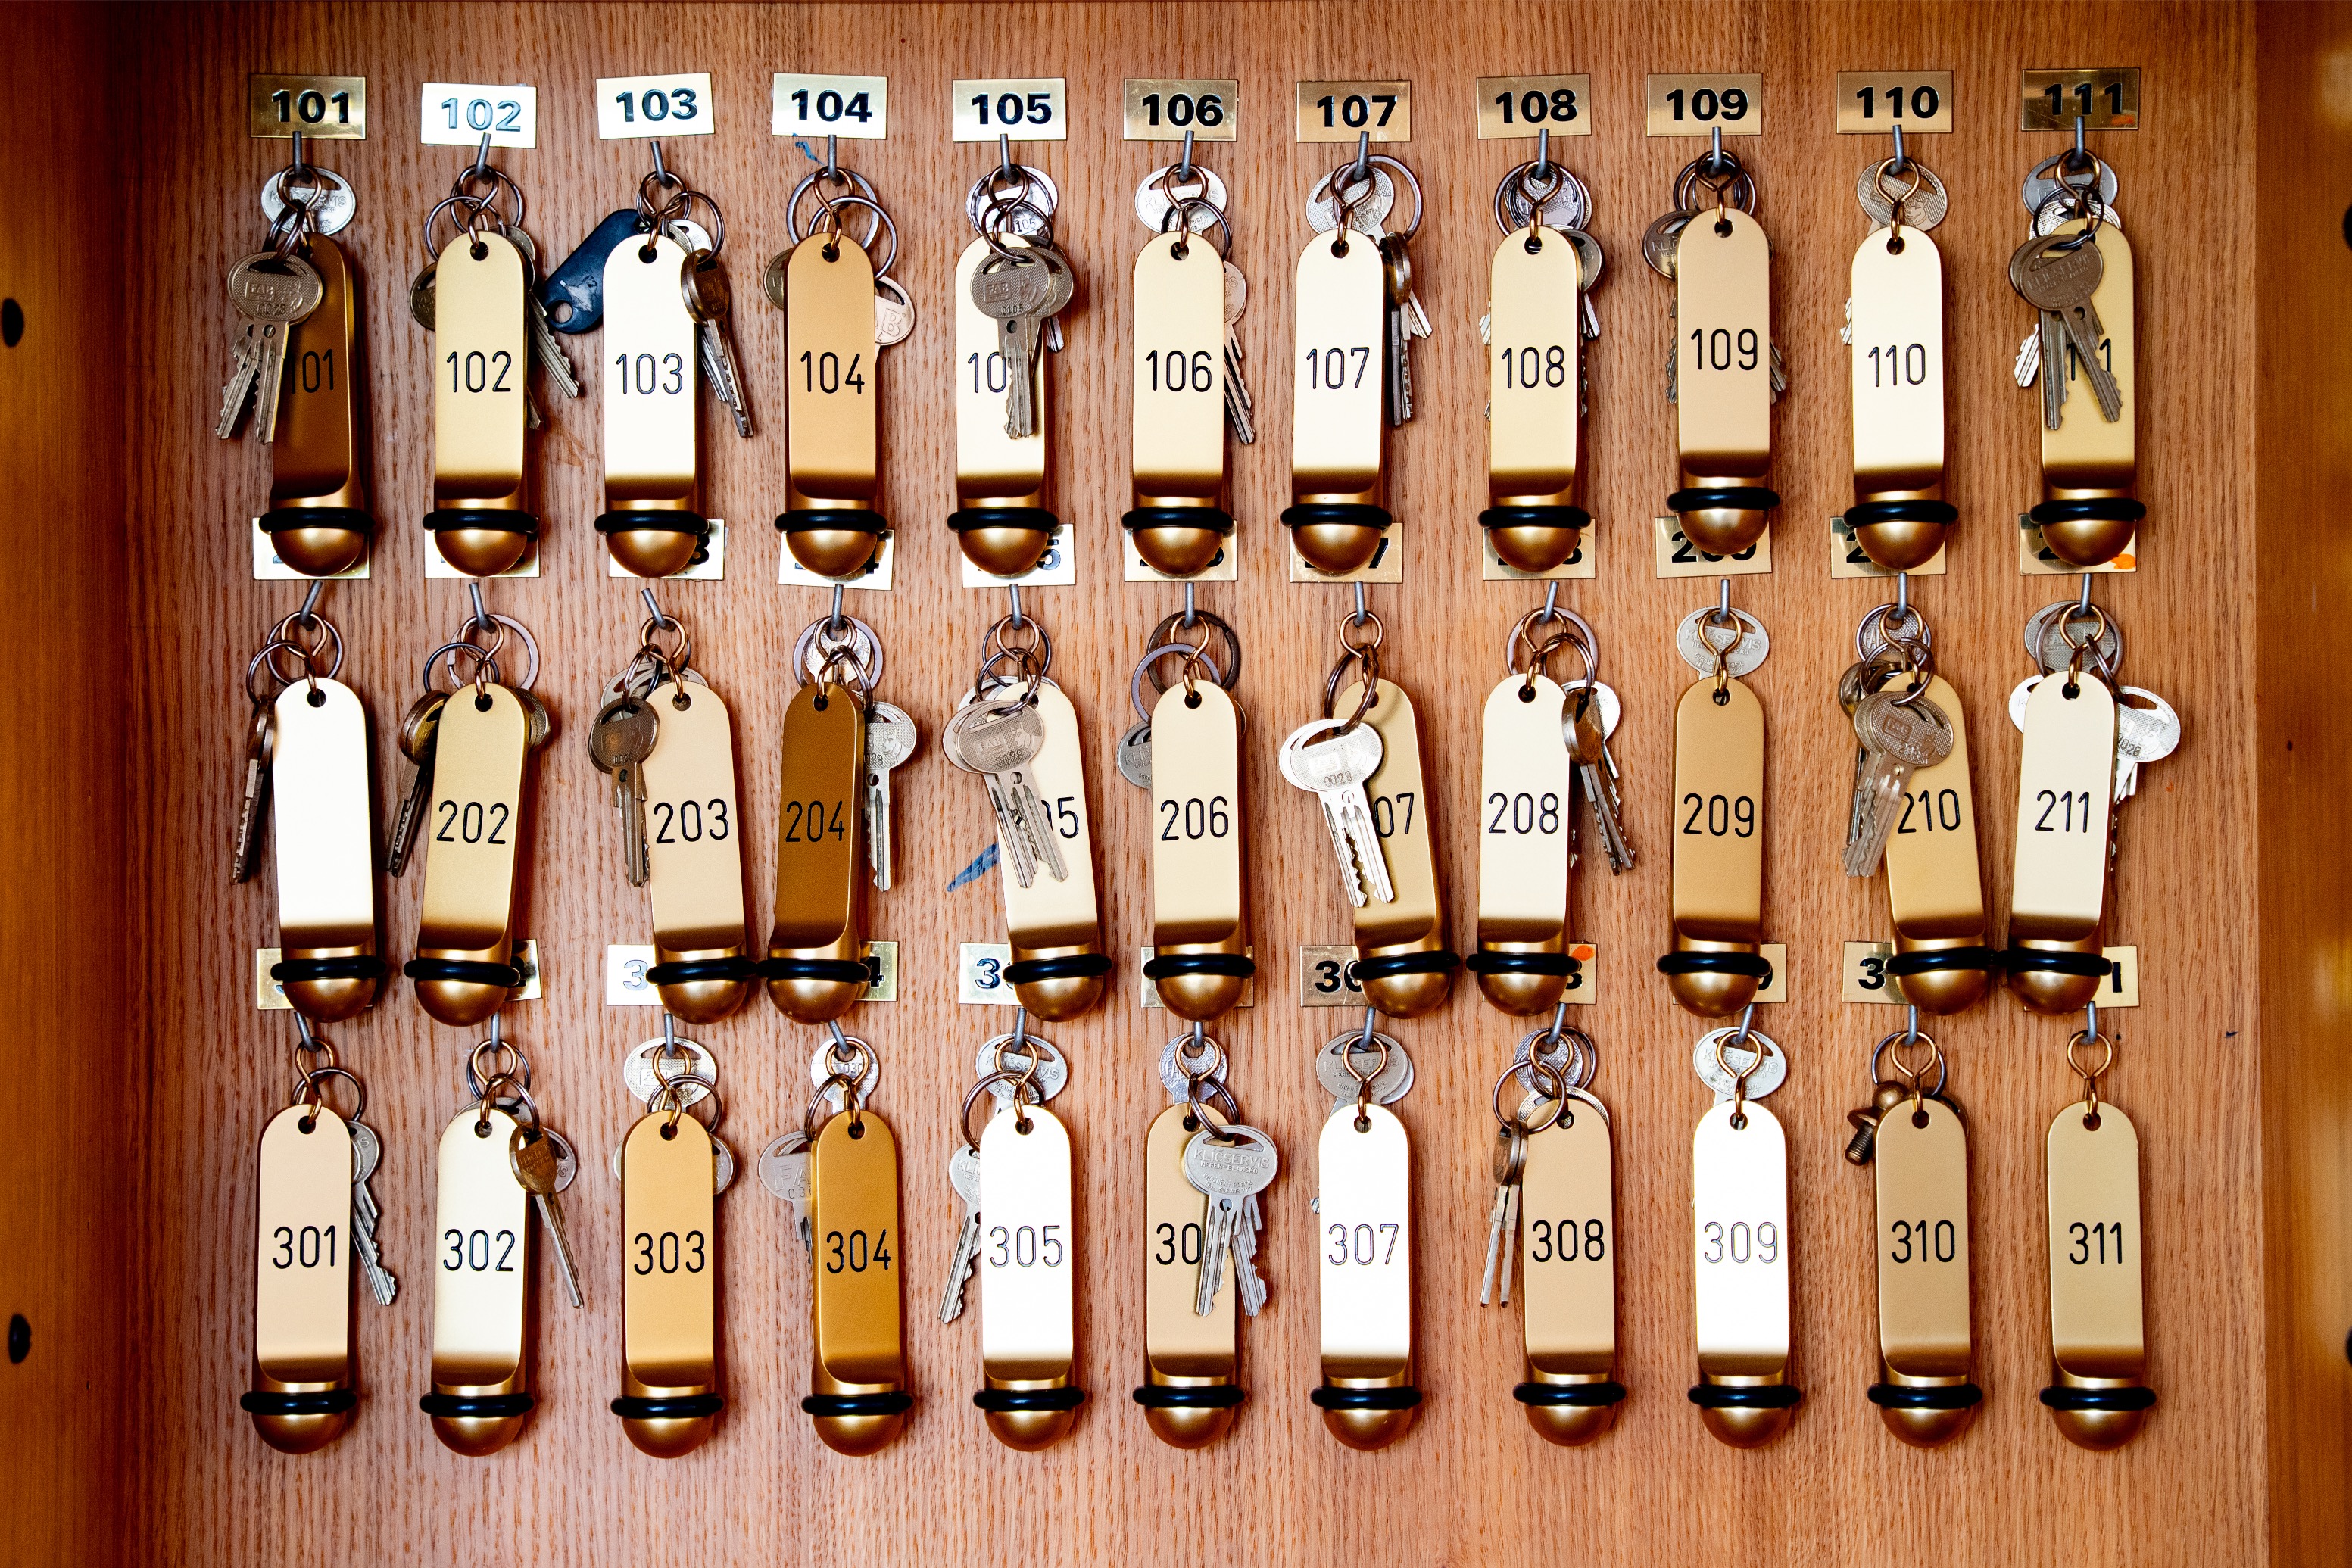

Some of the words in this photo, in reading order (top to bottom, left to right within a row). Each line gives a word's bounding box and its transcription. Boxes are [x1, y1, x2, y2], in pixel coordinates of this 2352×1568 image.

[272, 90, 349, 124] 101
[441, 97, 522, 132] 102
[616, 87, 698, 123] 103
[791, 89, 872, 123] 104
[972, 92, 1053, 125] 105
[1142, 93, 1224, 127] 106
[1316, 95, 1399, 129] 107
[1495, 89, 1578, 123] 108
[1666, 88, 1748, 122] 109
[1856, 86, 1939, 119] 110
[2045, 83, 2123, 115] 111
[1146, 350, 1212, 392] 106
[1306, 347, 1369, 389] 107
[1502, 345, 1564, 389] 108
[1691, 329, 1758, 371] 109
[1868, 343, 1926, 388] 110
[447, 351, 511, 393] 102
[616, 353, 682, 394] 103
[800, 351, 865, 394] 104
[968, 351, 1007, 393] 10
[437, 800, 507, 844] 202
[654, 798, 728, 844] 203
[785, 800, 845, 843] 204
[1161, 796, 1228, 841] 206
[1374, 792, 1414, 838] 07
[1489, 792, 1558, 834] 208
[1683, 793, 1754, 838] 209
[1898, 788, 1961, 834] 210
[2035, 790, 2089, 833] 211
[1194, 1147, 1270, 1169] KLÍČSERVIS
[273, 1225, 335, 1269] 301
[443, 1229, 515, 1272] 302
[634, 1230, 704, 1275] 303
[827, 1229, 891, 1273] 304
[990, 1225, 1062, 1268] 305
[1156, 1222, 1202, 1265] 30
[1329, 1224, 1399, 1266] 307
[1533, 1219, 1605, 1262] 308
[1705, 1222, 1777, 1264] 309
[1892, 1220, 1955, 1264] 310
[2069, 1222, 2122, 1265] 311
